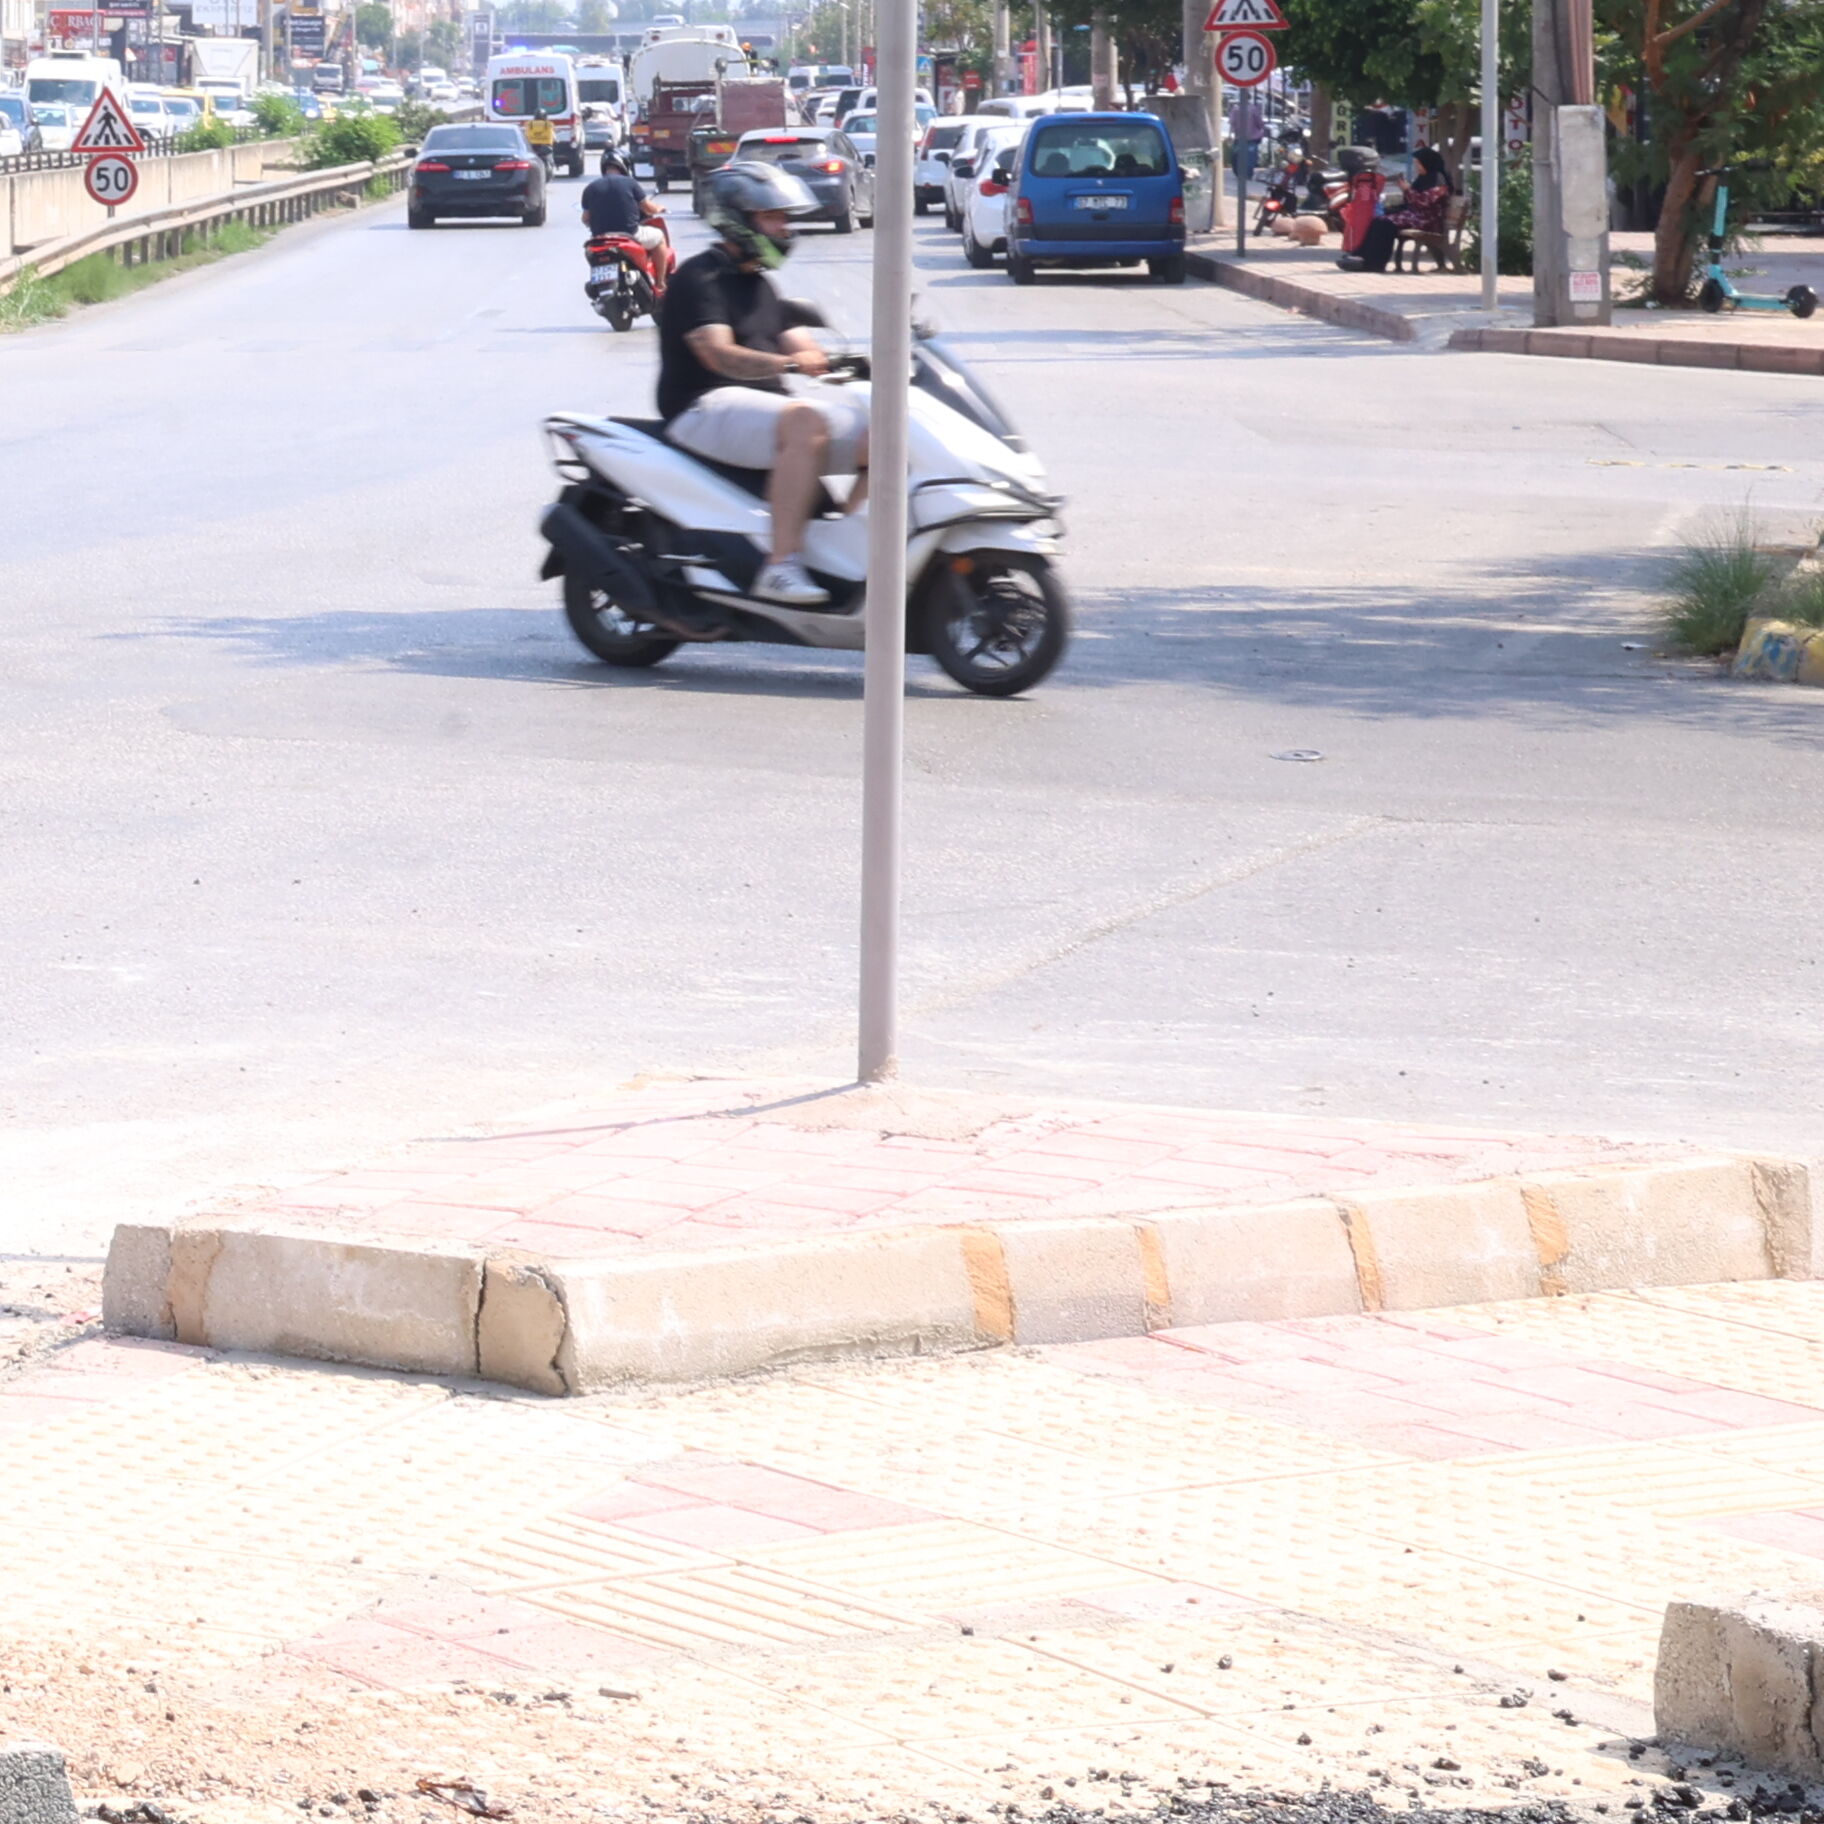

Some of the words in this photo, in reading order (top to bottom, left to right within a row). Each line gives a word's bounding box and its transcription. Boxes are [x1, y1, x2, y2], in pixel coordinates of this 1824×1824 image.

[500, 65, 556, 75] AMBULANS
[1228, 45, 1264, 72] 50
[95, 166, 129, 192] 50
